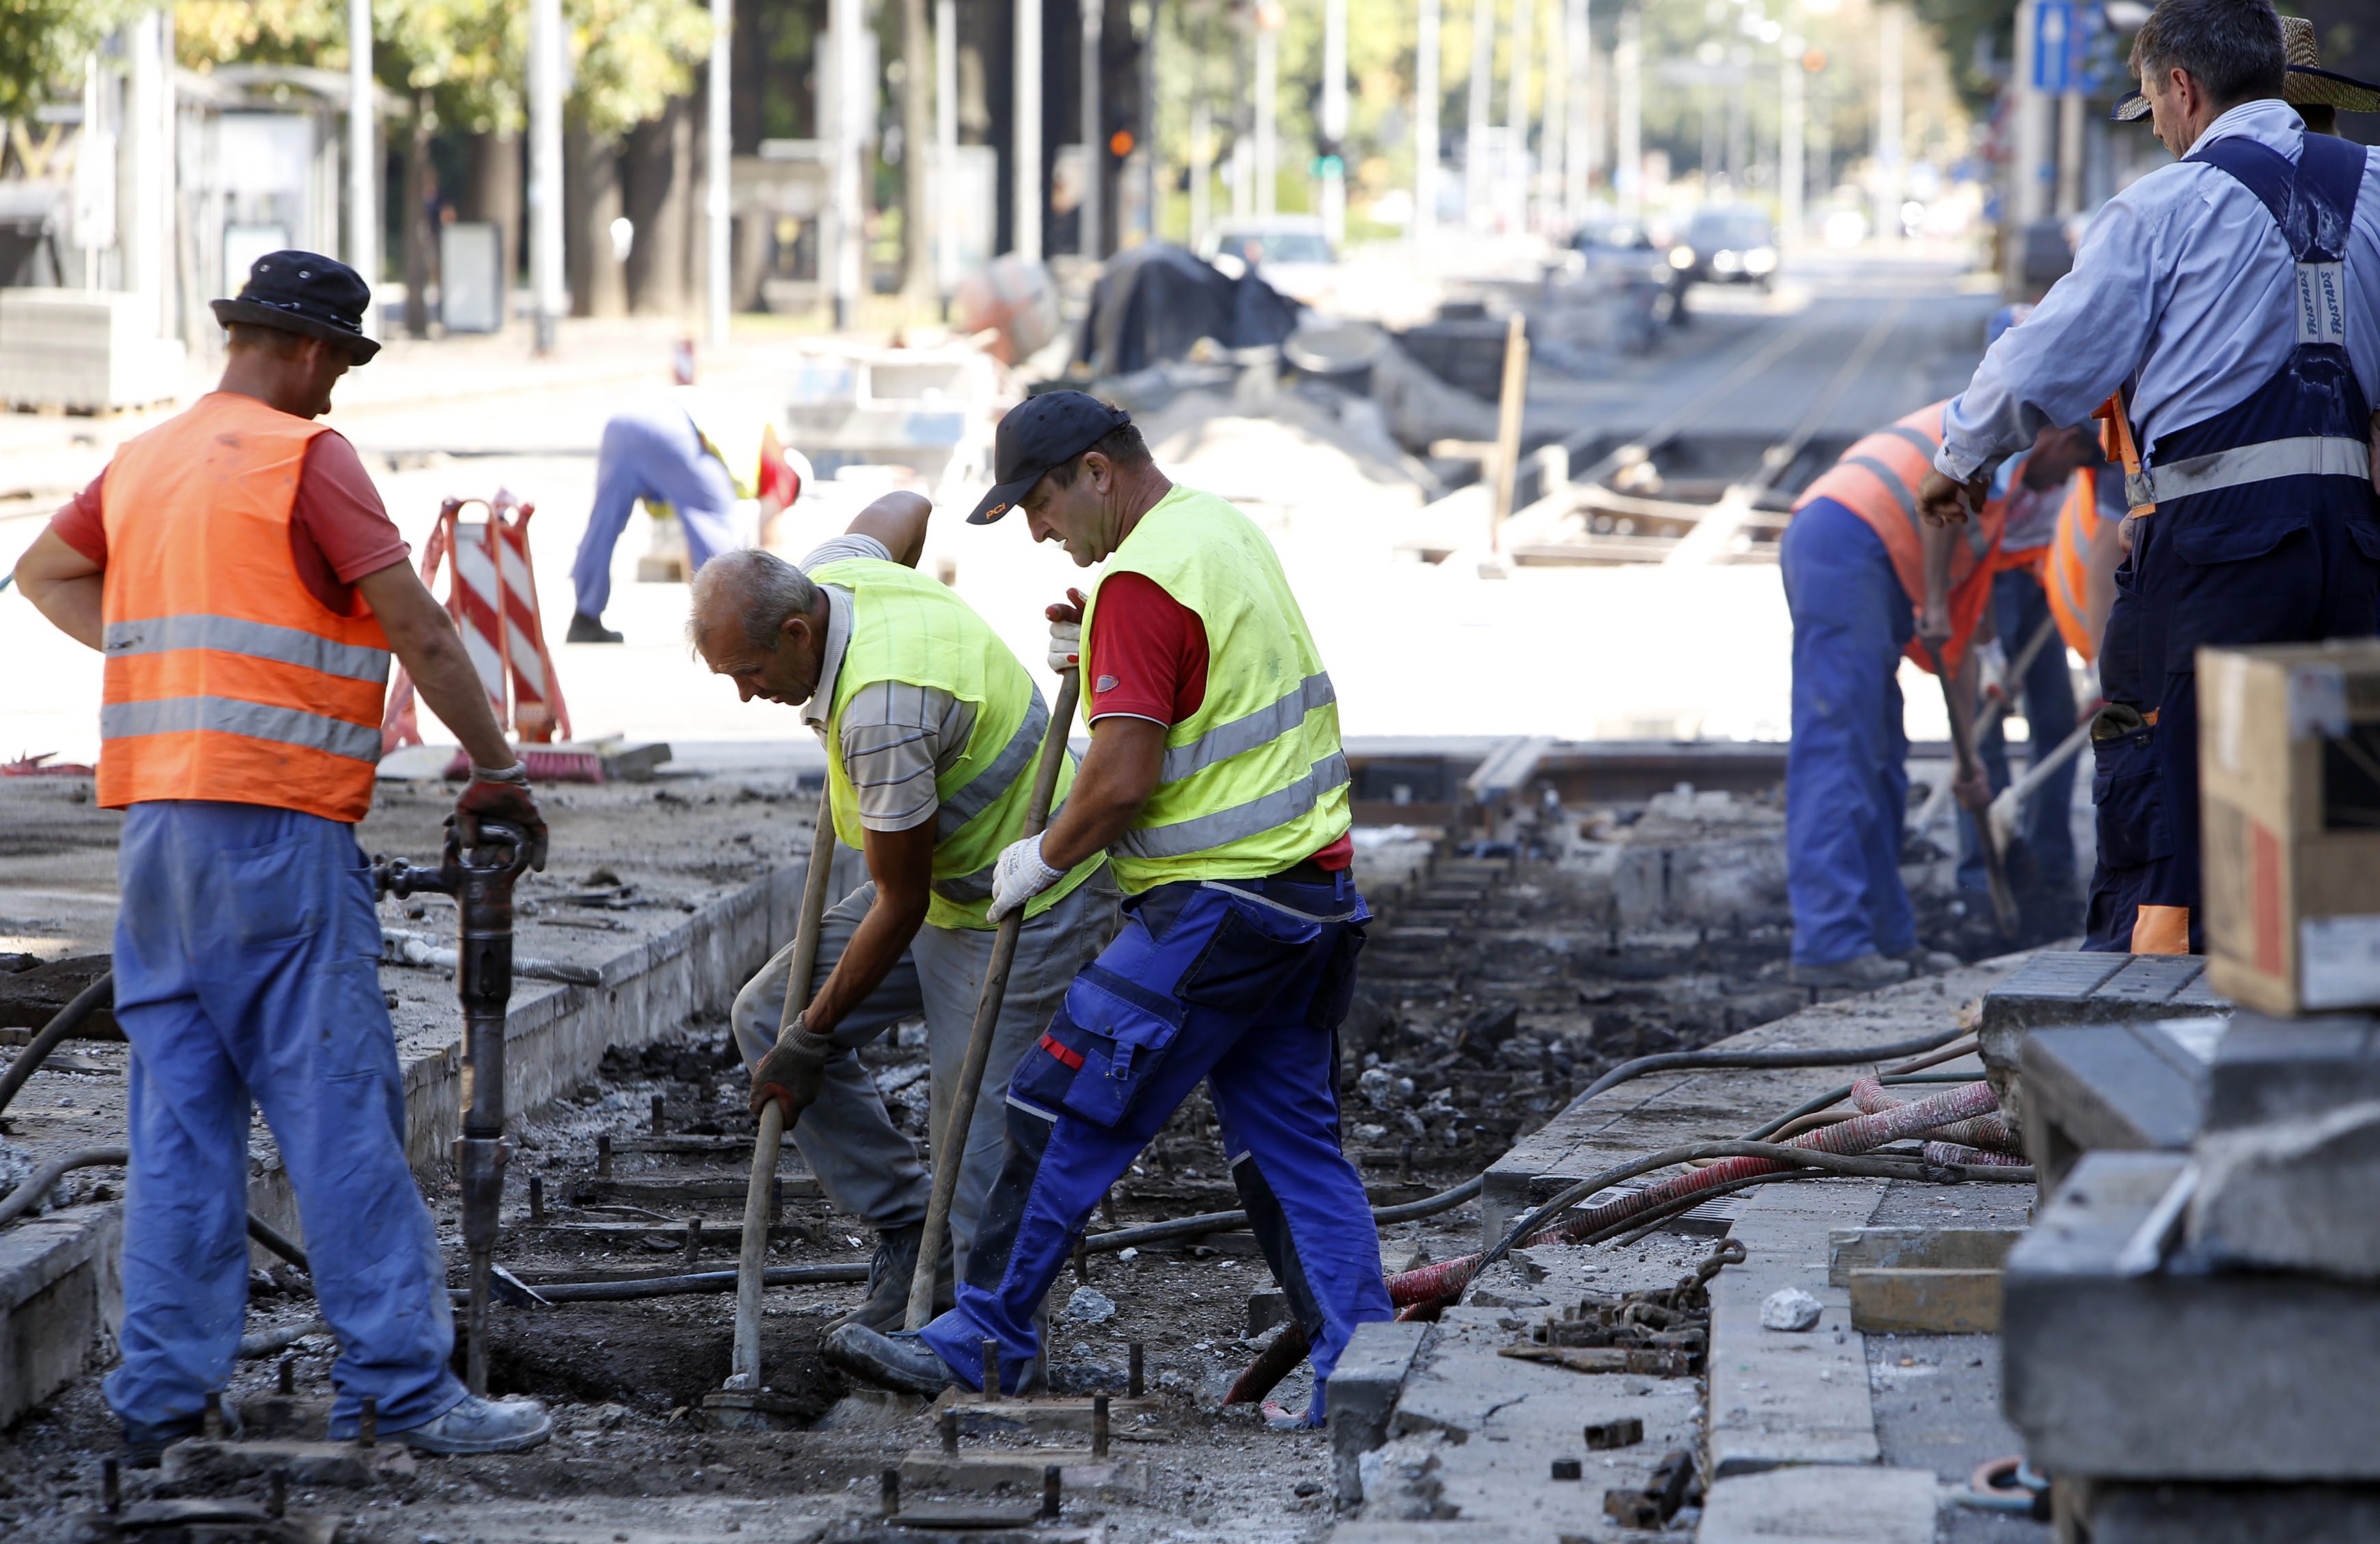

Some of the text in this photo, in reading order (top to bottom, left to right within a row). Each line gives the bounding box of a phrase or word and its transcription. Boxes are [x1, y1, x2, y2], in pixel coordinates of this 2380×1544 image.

[2299, 270, 2317, 335] FRISTADS
[2321, 271, 2342, 335] FRISTADS
[986, 503, 1006, 519] PCI
